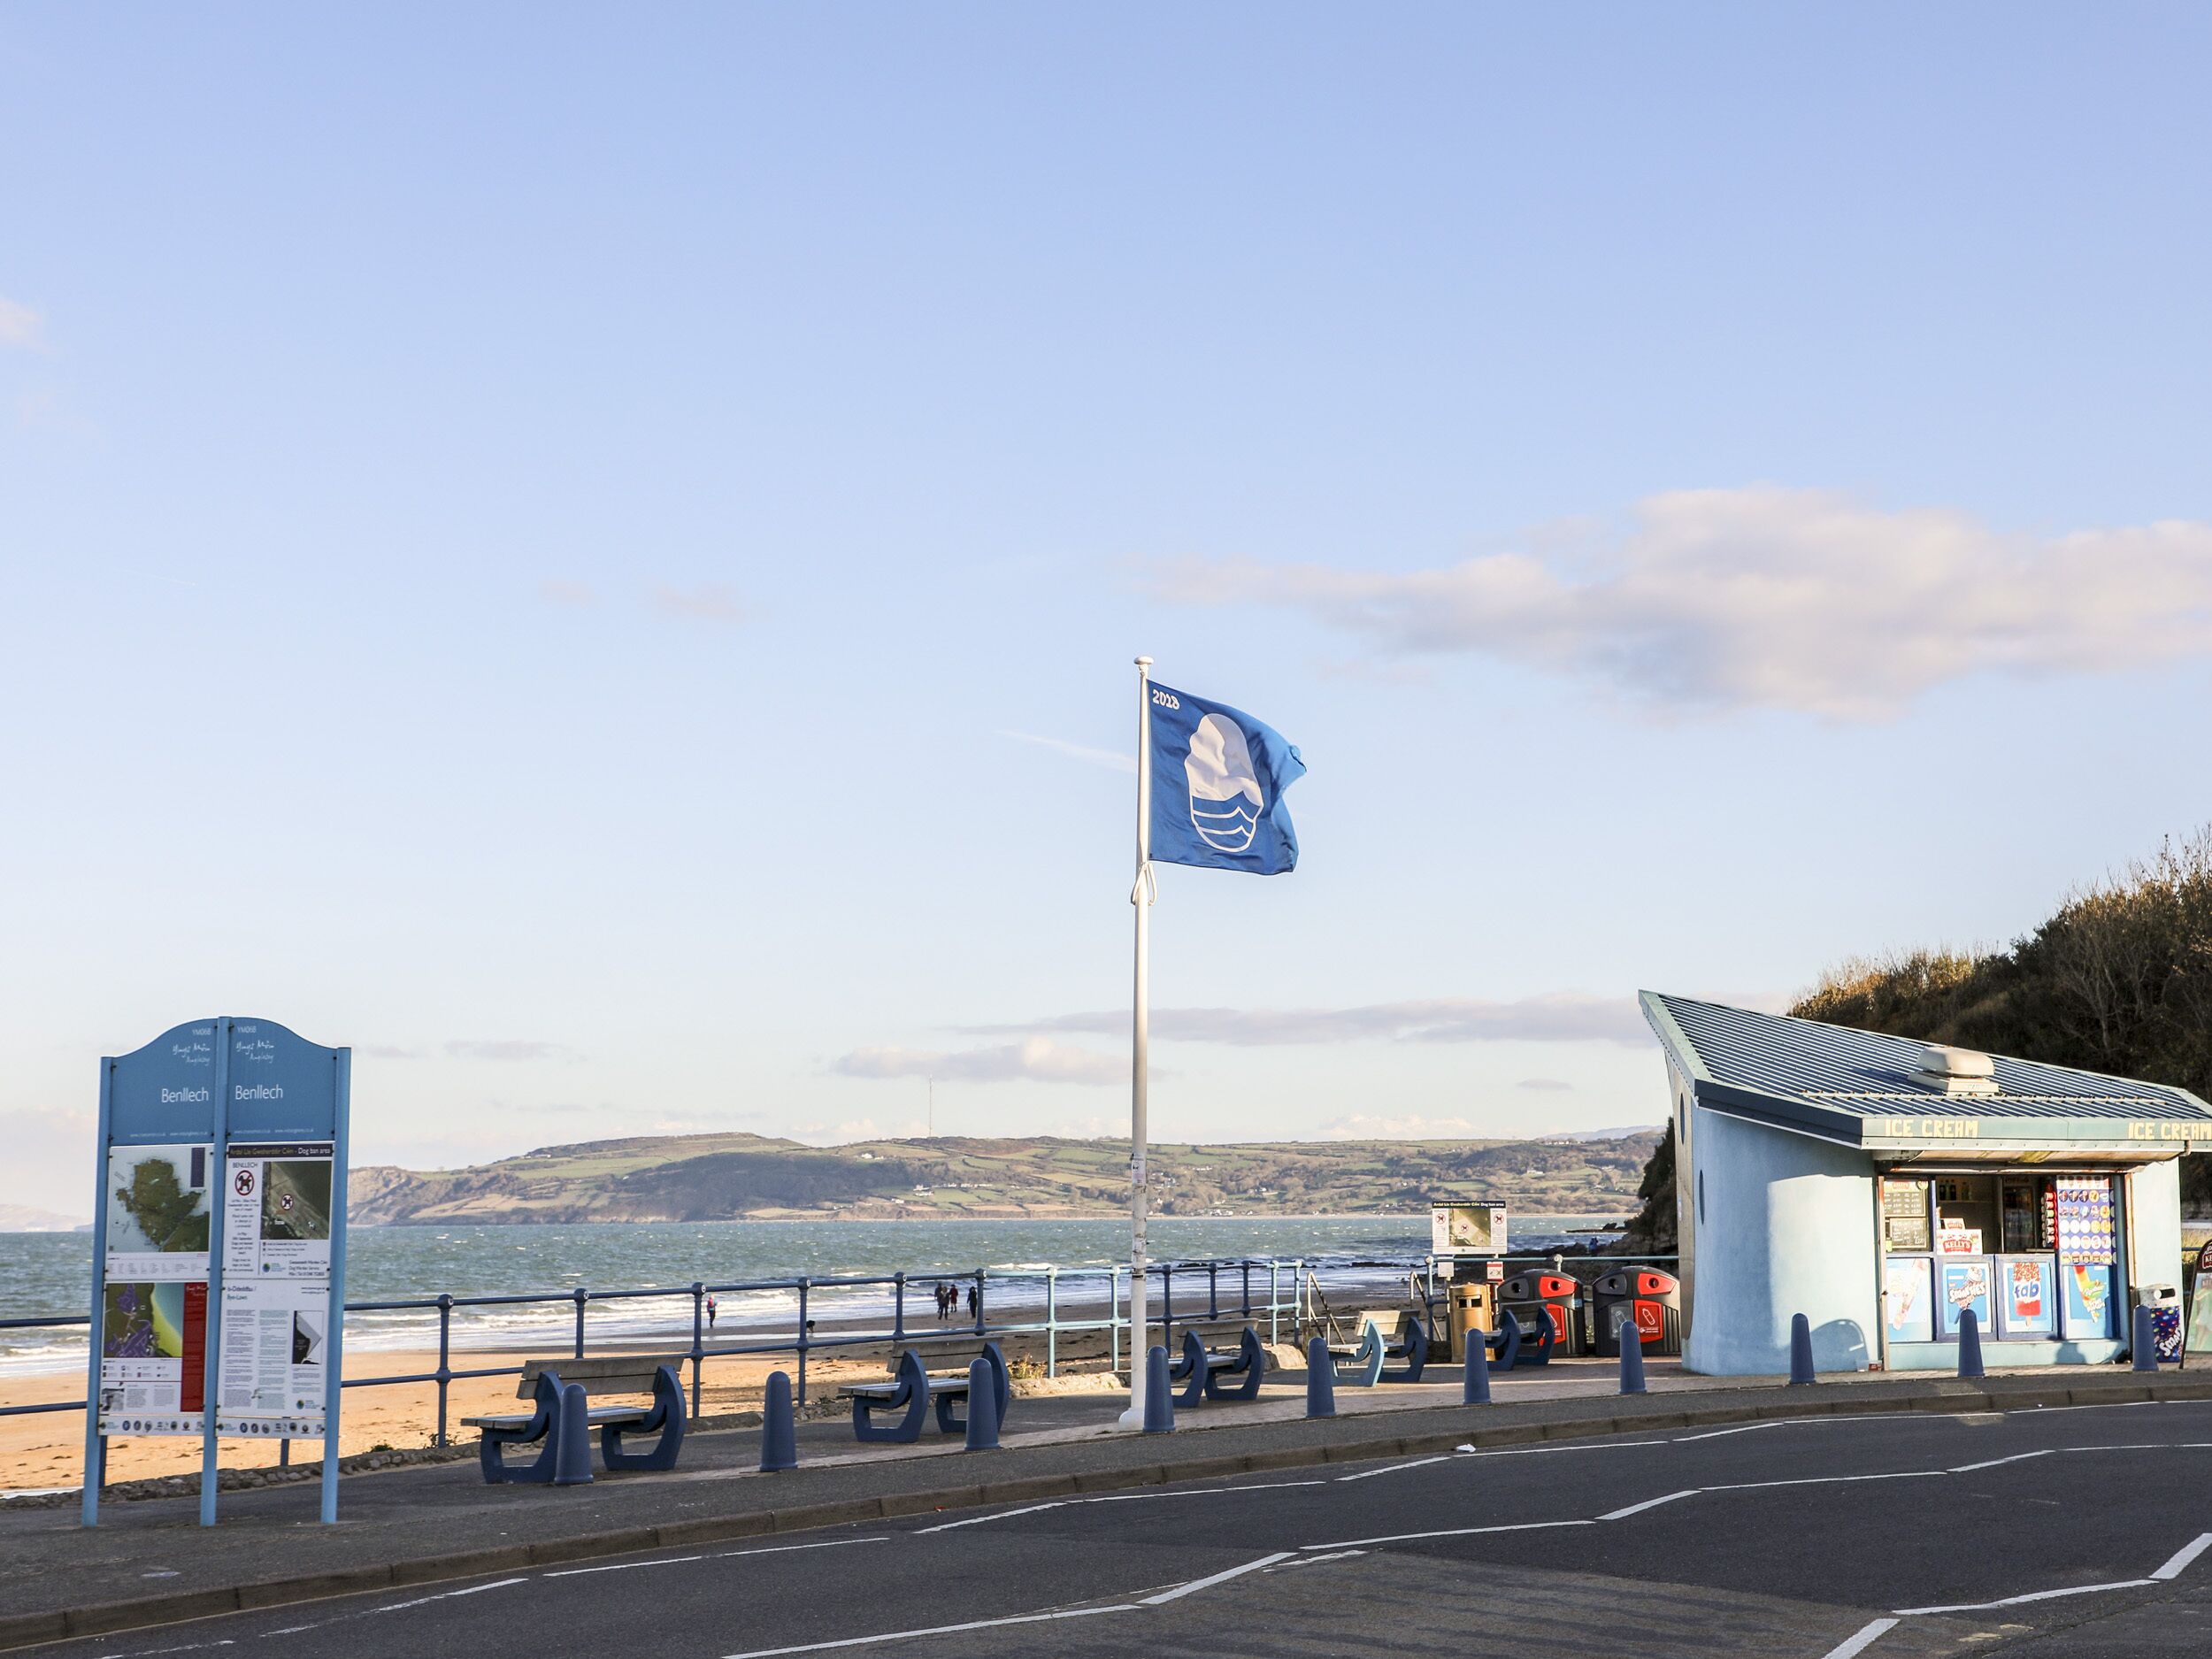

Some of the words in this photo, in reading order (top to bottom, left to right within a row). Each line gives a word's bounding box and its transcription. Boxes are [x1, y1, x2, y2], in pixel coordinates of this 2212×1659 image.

[1152, 688, 1180, 710] 2018
[161, 1087, 209, 1102] Benllech
[235, 1084, 283, 1100] Benllech
[1885, 1118, 1914, 1137] ICE
[1921, 1119, 1978, 1138] CREAM
[2128, 1122, 2155, 1140] ICE
[2161, 1122, 2212, 1140] CREAM
[297, 1147, 310, 1156] Dog
[1944, 1240, 1972, 1249] KELLY'S
[2015, 1281, 2039, 1299] fab
